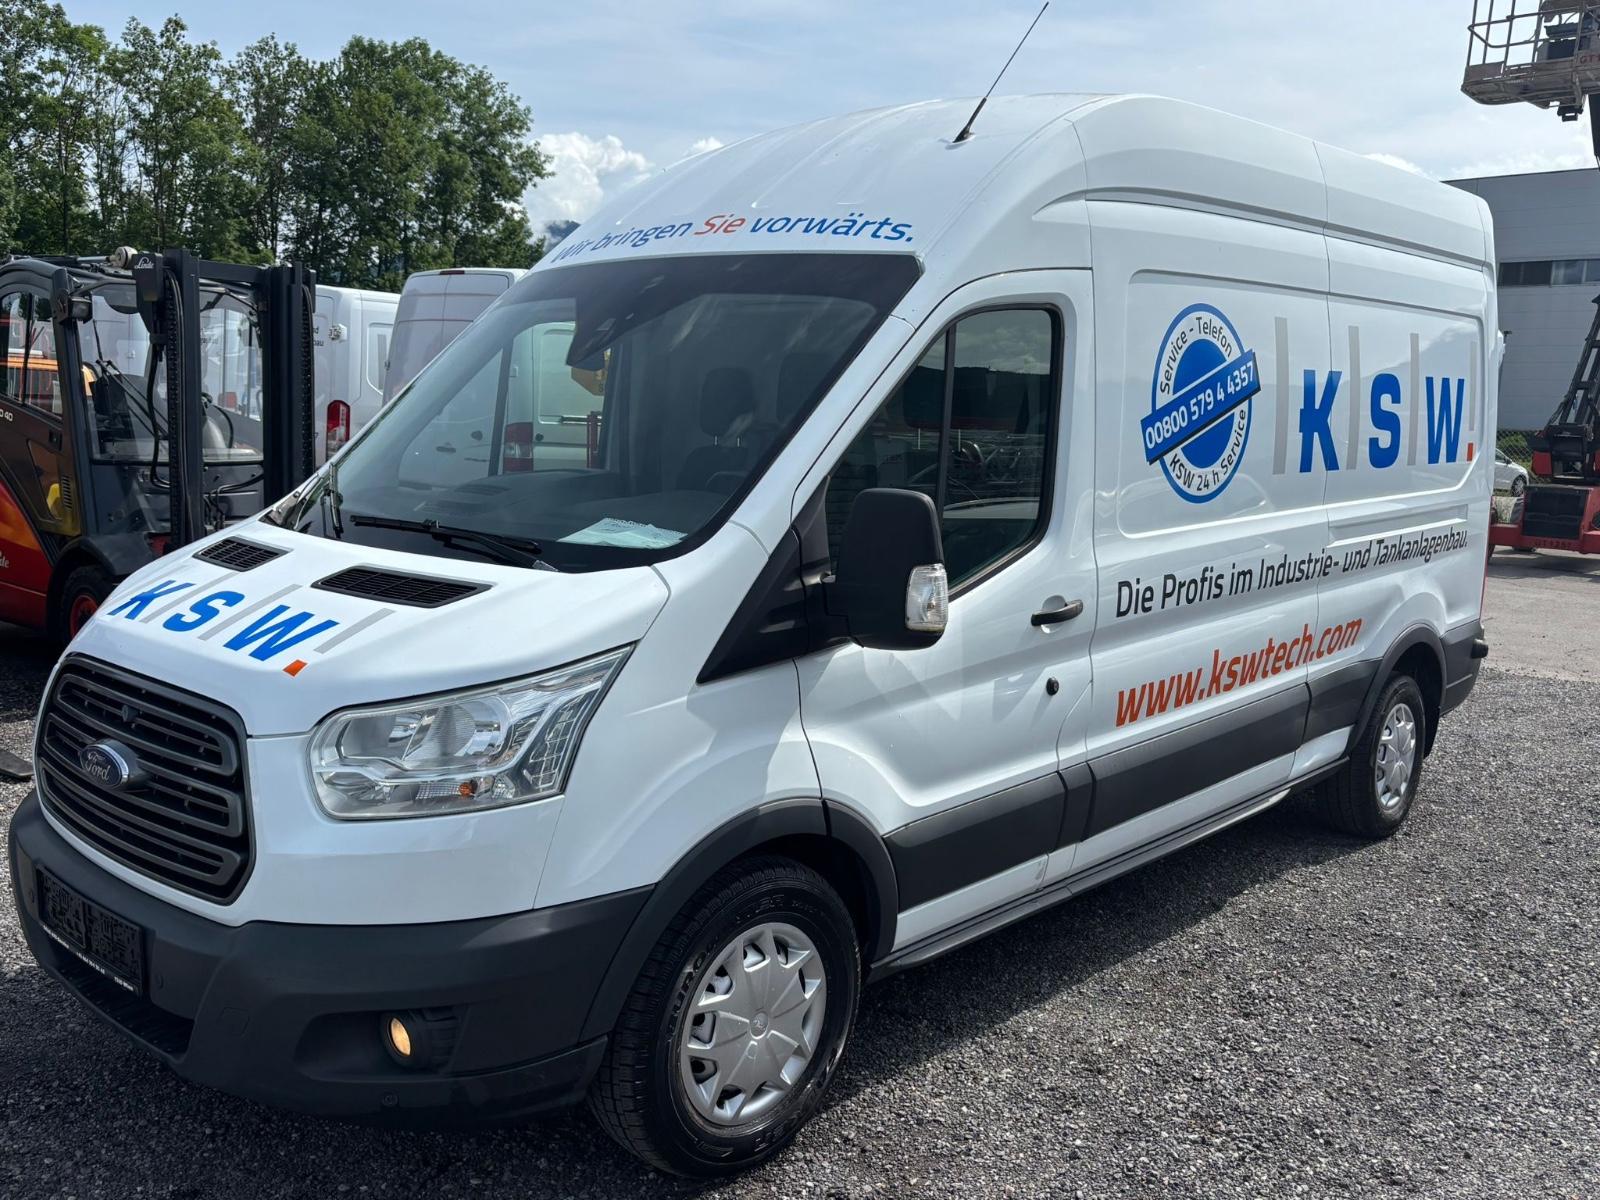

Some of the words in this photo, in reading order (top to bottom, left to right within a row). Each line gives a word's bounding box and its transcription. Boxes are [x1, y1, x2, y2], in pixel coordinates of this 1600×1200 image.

[551, 239, 594, 263] Wir
[591, 221, 694, 253] bringen
[694, 213, 747, 236] Sie
[749, 212, 914, 243] vorwärts.
[1160, 334, 1187, 395] Service
[1195, 316, 1234, 358] Telefon
[1145, 409, 1188, 449] 00800
[1190, 388, 1215, 421] 579
[1216, 383, 1226, 403] 4
[1227, 361, 1255, 395] 4357
[1169, 453, 1196, 491] KSW
[1196, 473, 1211, 492] 24
[1211, 470, 1221, 486] h
[1221, 408, 1248, 476] Service
[1115, 578, 1154, 618] Die
[1161, 565, 1225, 610] Profis
[1229, 562, 1253, 596] im
[1257, 546, 1340, 591] Industrie-
[1342, 540, 1372, 573] und
[1374, 527, 1468, 565] Tankanlagenbau.
[1115, 617, 1362, 728] www.kswtech.com
[84, 751, 112, 781] Ford
